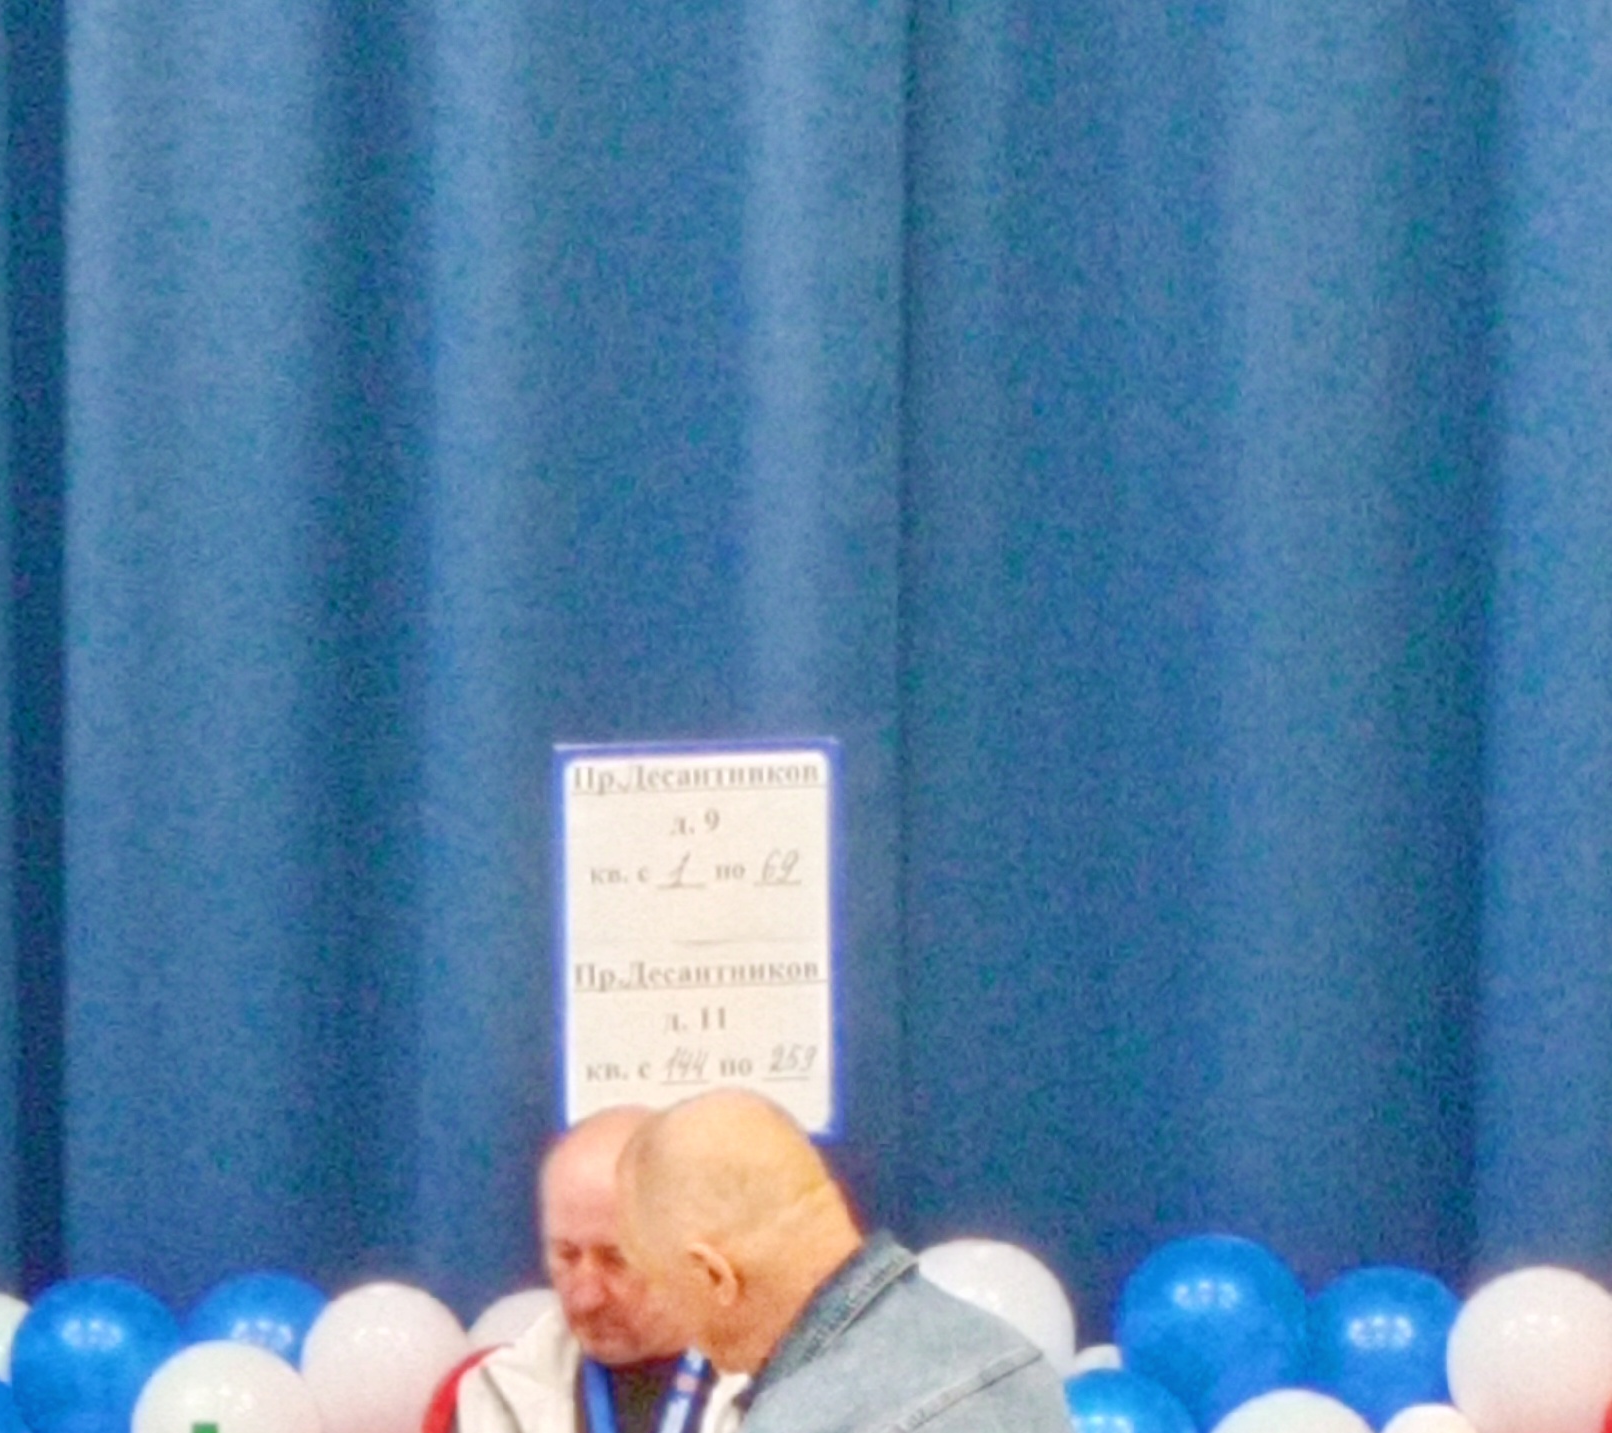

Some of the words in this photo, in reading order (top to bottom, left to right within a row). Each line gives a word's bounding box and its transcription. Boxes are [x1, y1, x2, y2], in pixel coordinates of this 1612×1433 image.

[573, 764, 819, 795] Пр.Десантников
[705, 810, 720, 833] 9
[590, 865, 628, 884] кв.
[637, 866, 649, 882] с
[668, 851, 692, 887] 1
[715, 862, 745, 880] по
[575, 961, 819, 992] Пр.Десантников
[700, 1006, 727, 1029] 11
[586, 1063, 628, 1082] кв.
[638, 1061, 651, 1077] с
[664, 1045, 709, 1079] 144
[719, 1055, 753, 1077] по
